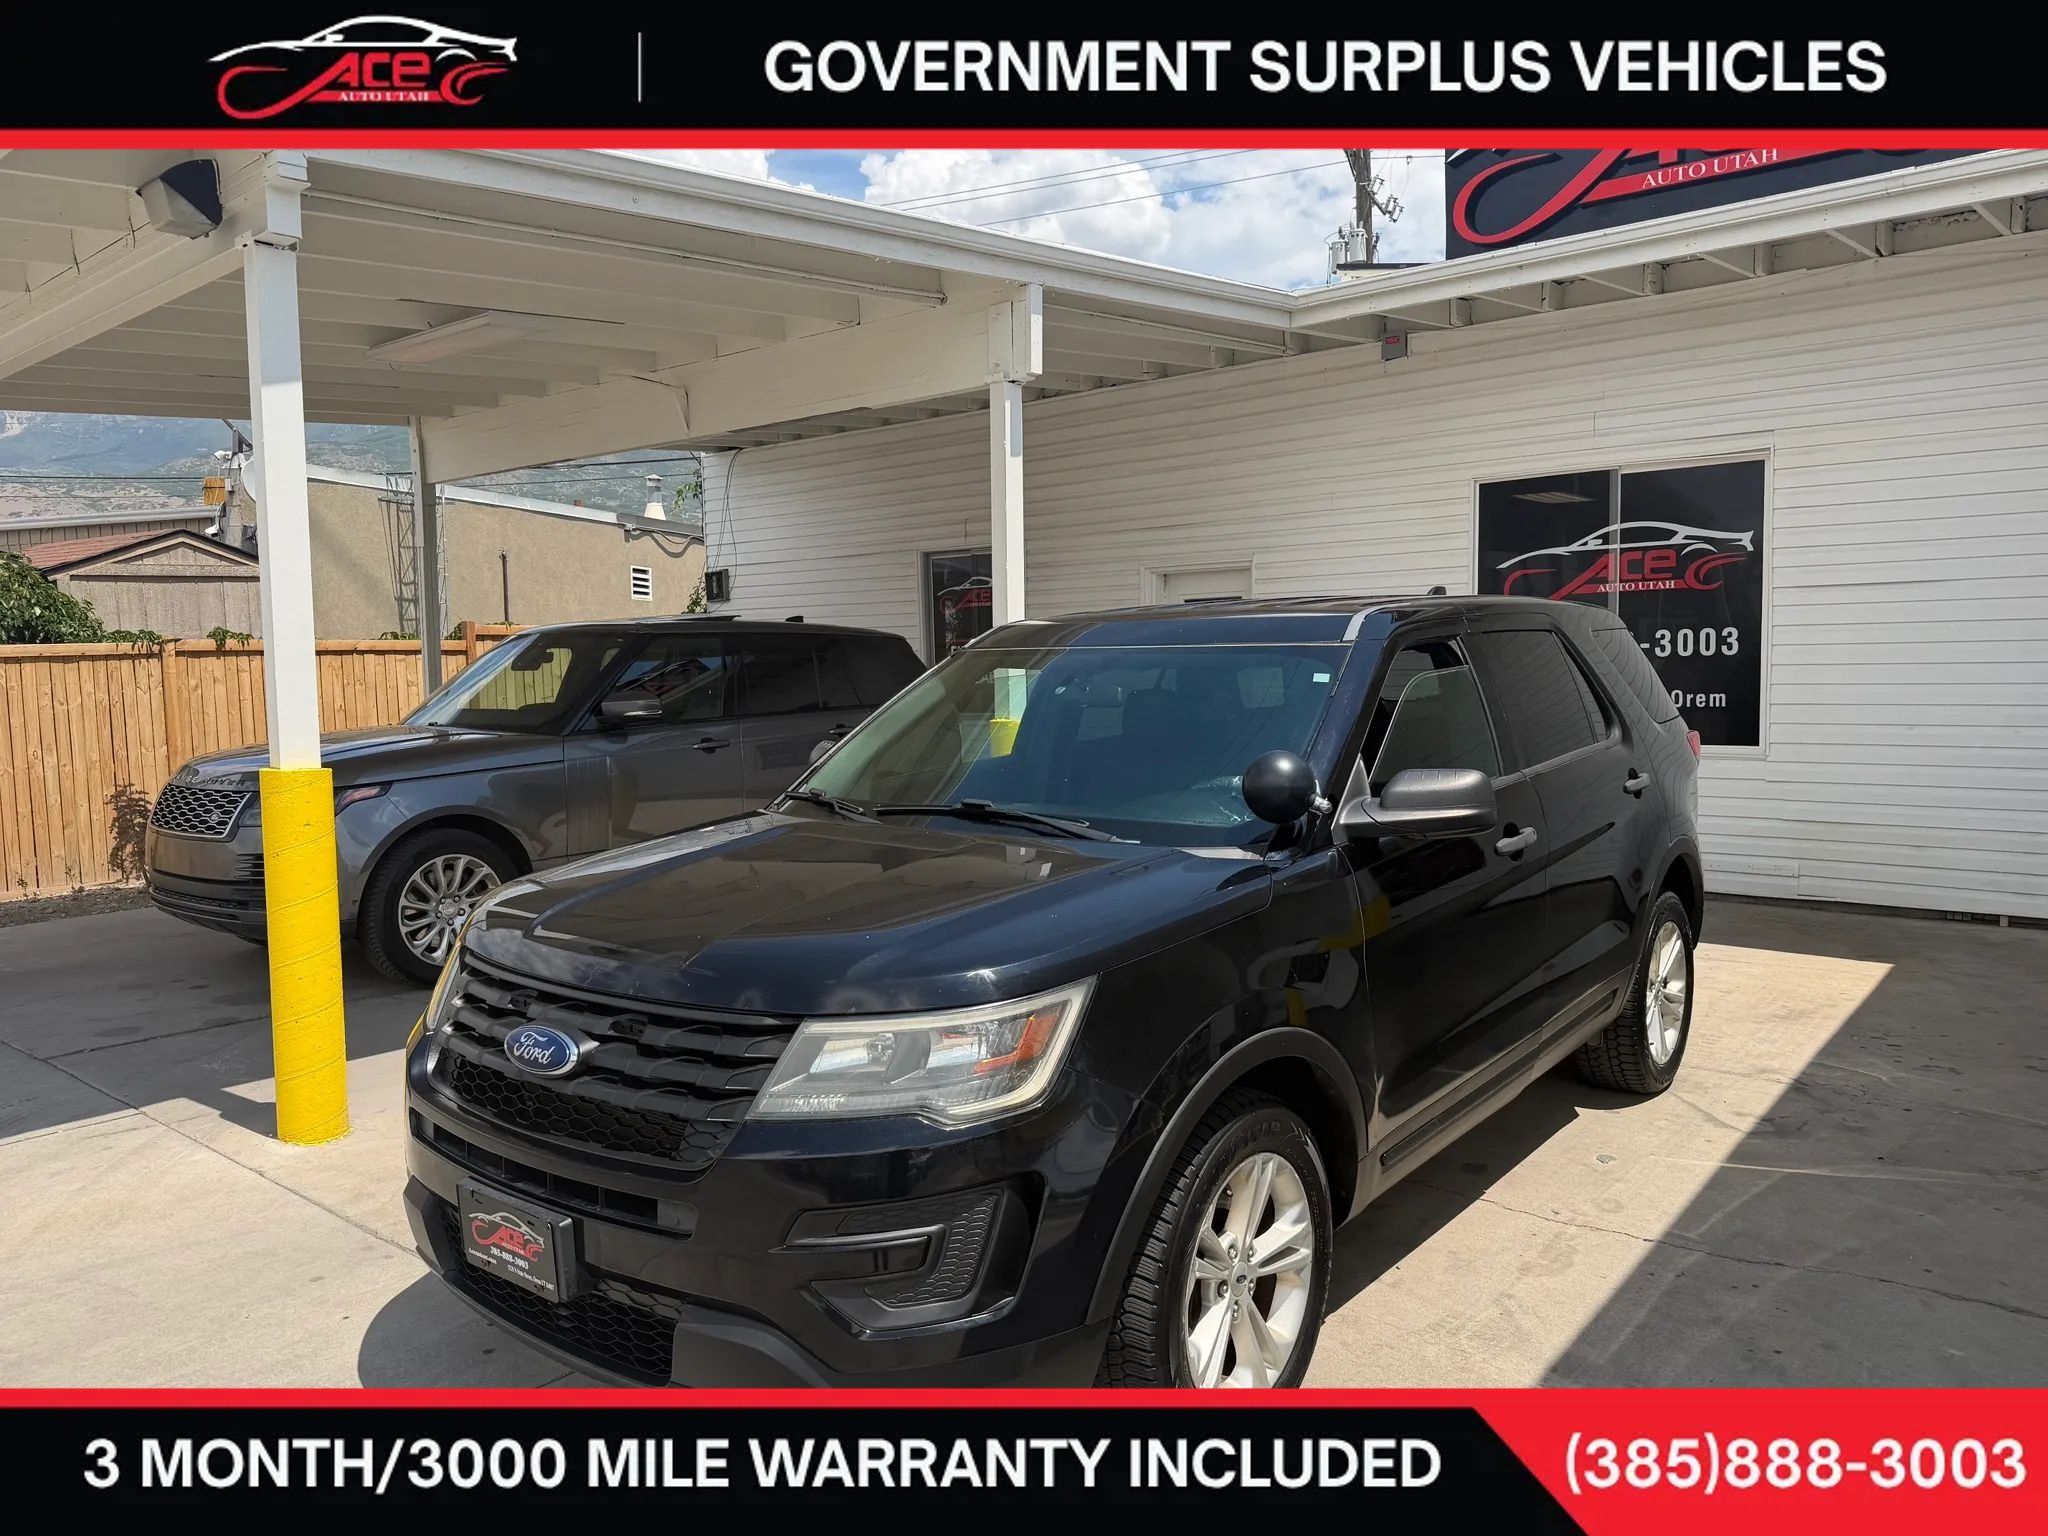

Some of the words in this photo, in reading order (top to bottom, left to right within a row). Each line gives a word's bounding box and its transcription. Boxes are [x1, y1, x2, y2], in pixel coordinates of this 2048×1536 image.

[1642, 162, 1706, 189] AUTO
[1713, 148, 1779, 173] UTAH
[1597, 582, 1635, 593] AUTO
[1638, 580, 1676, 590] UTAH
[1630, 626, 1739, 658] -3003
[1671, 689, 1726, 707] Orem
[514, 1032, 555, 1064] Ford
